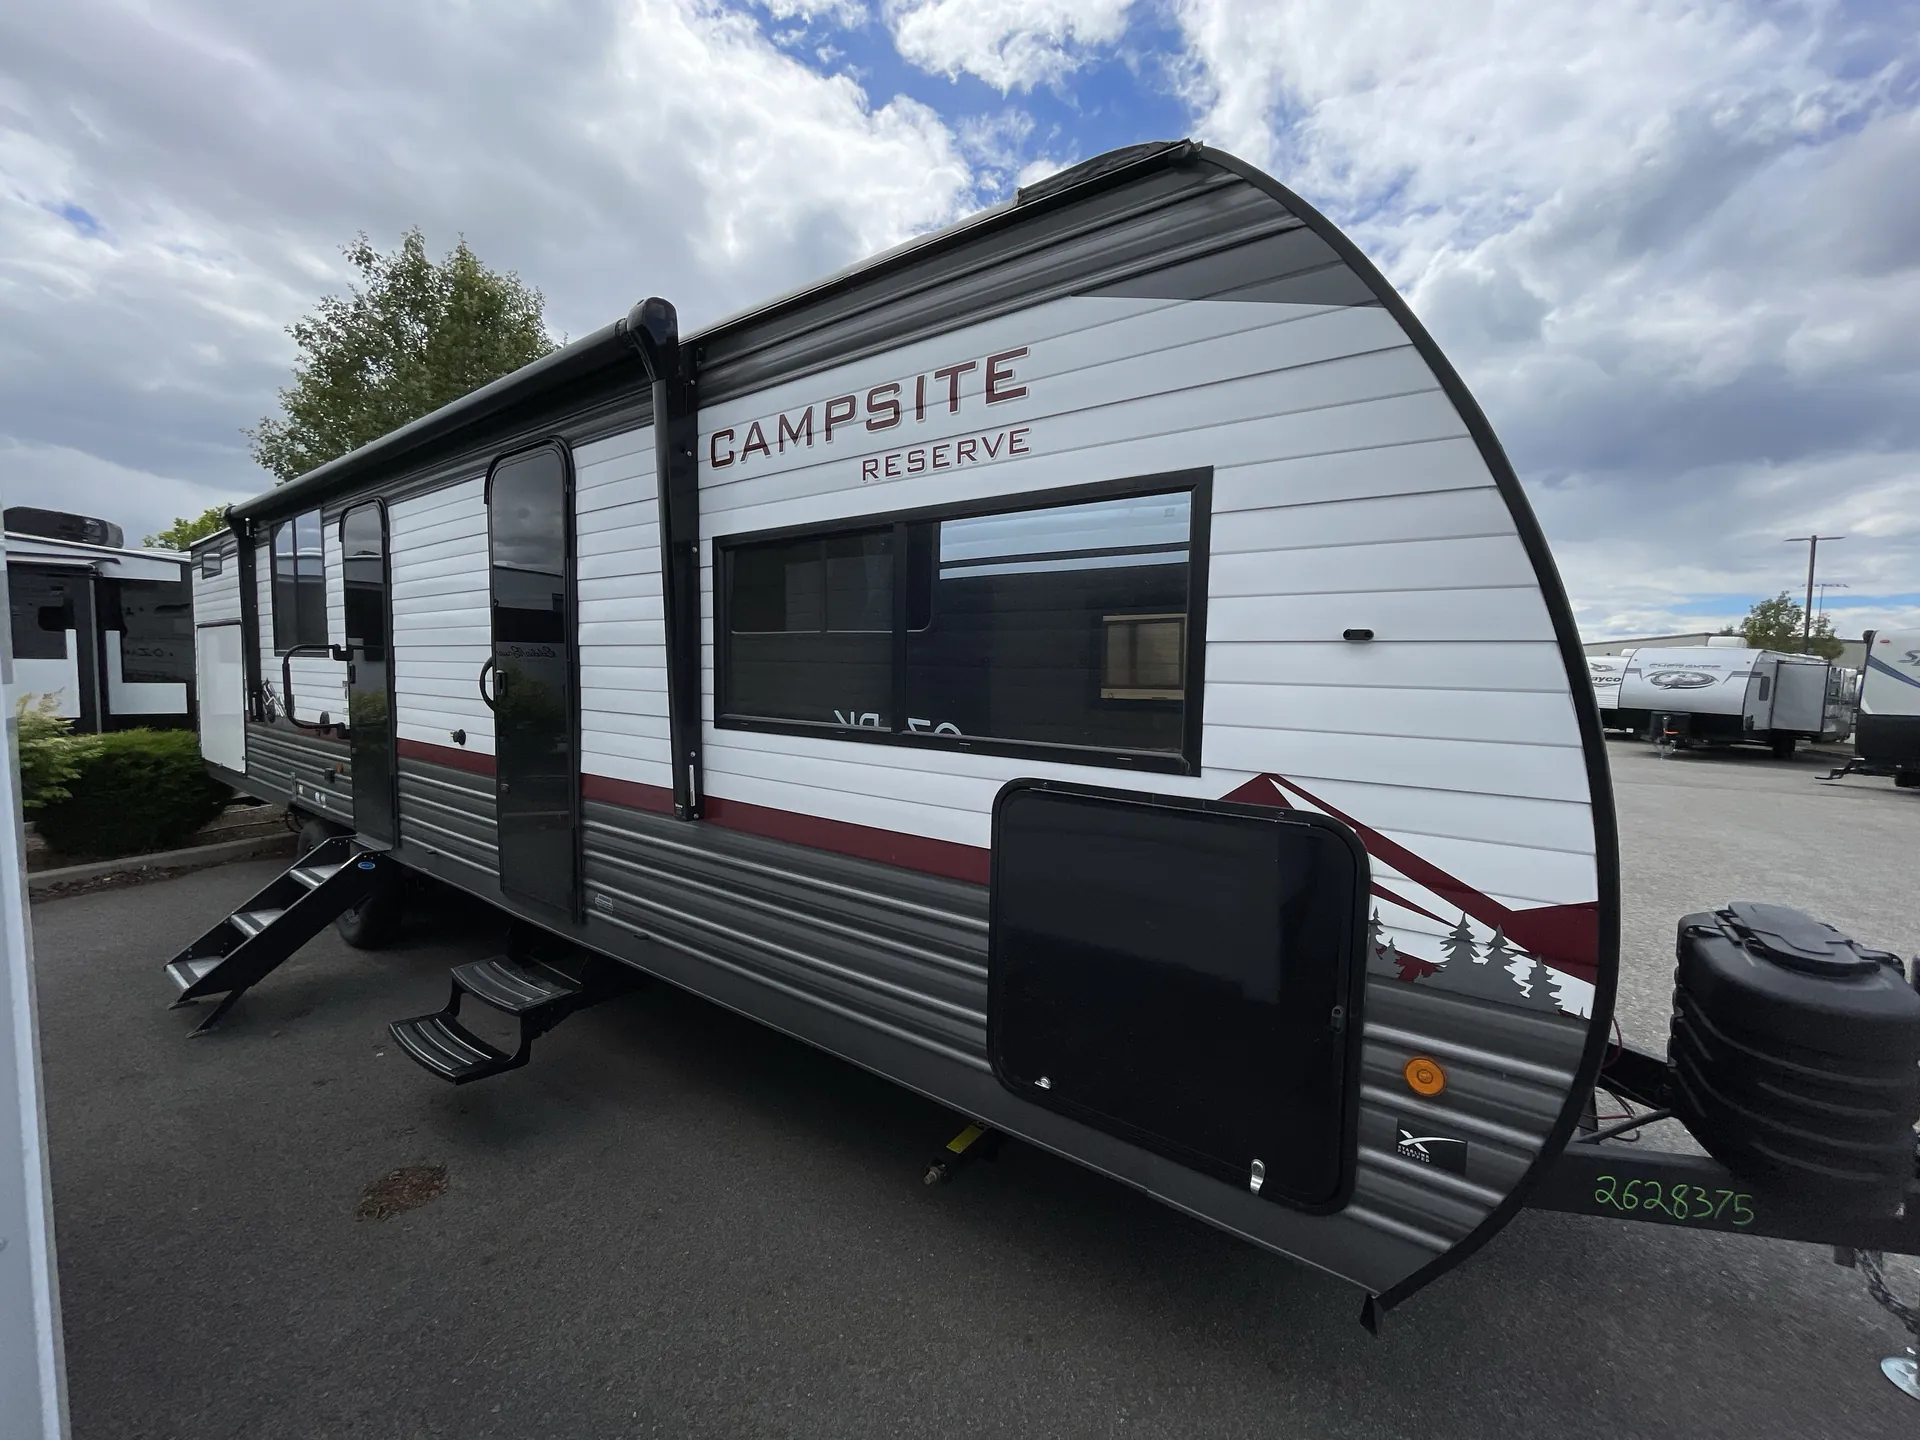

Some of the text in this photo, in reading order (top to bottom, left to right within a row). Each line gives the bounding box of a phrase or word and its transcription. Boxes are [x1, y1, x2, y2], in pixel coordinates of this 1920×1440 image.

[711, 346, 1028, 468] CAMPSITE
[862, 428, 1030, 481] RESERVE
[1594, 1175, 1755, 1226] 2628375
